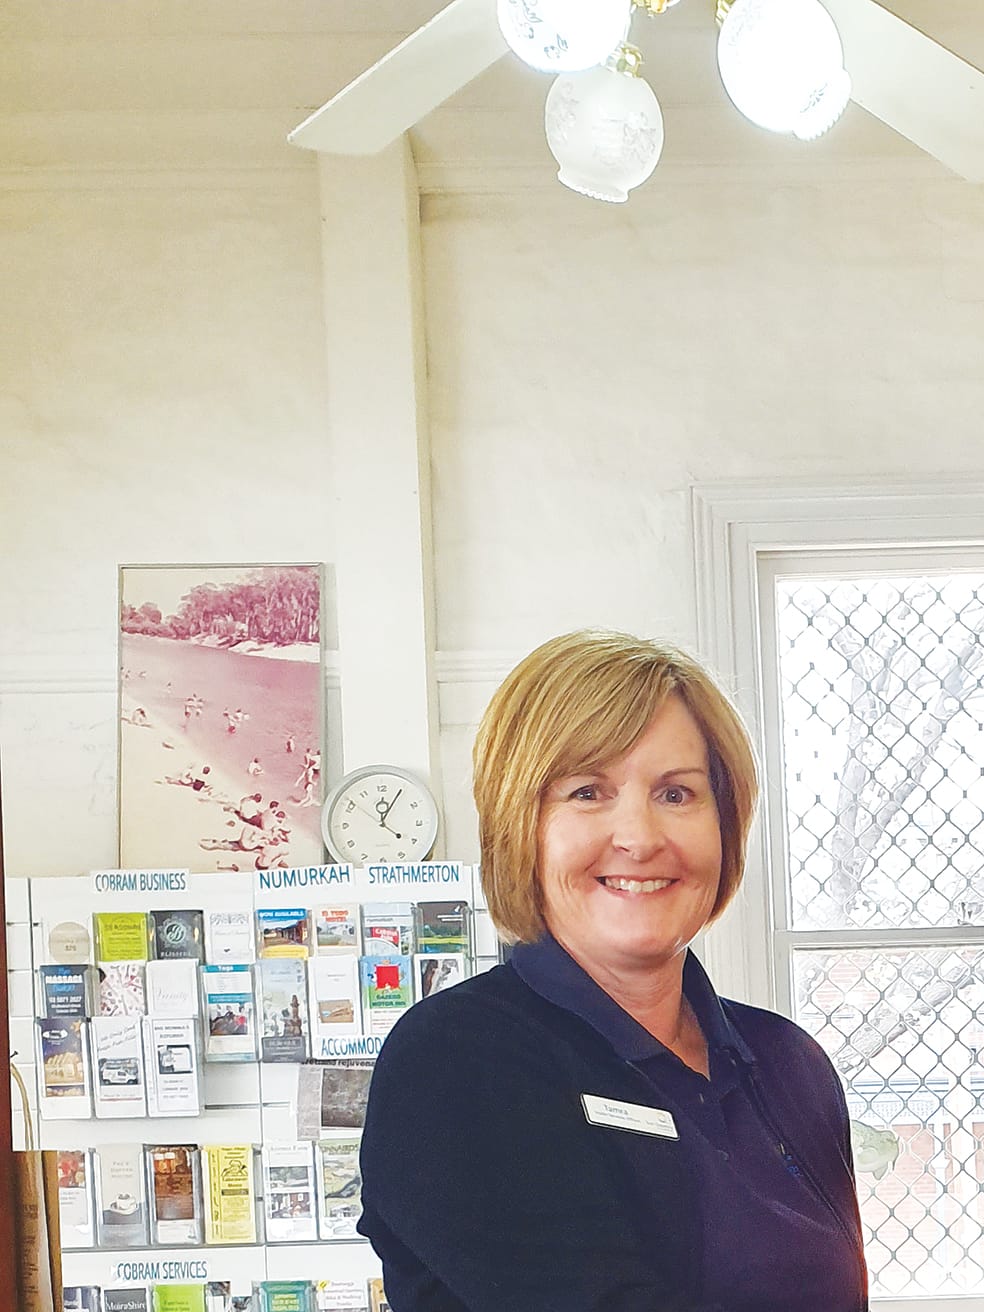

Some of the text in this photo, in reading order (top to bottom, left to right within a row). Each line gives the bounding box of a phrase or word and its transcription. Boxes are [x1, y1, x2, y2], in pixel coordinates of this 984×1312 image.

[95, 873, 186, 892] COBRAM BUSINESS
[259, 865, 350, 890] NUMURKAH
[368, 865, 459, 884] STRATHMERTON
[321, 1036, 383, 1056] ACCOMMOD
[117, 1261, 207, 1280] COBRAM SERVICES
